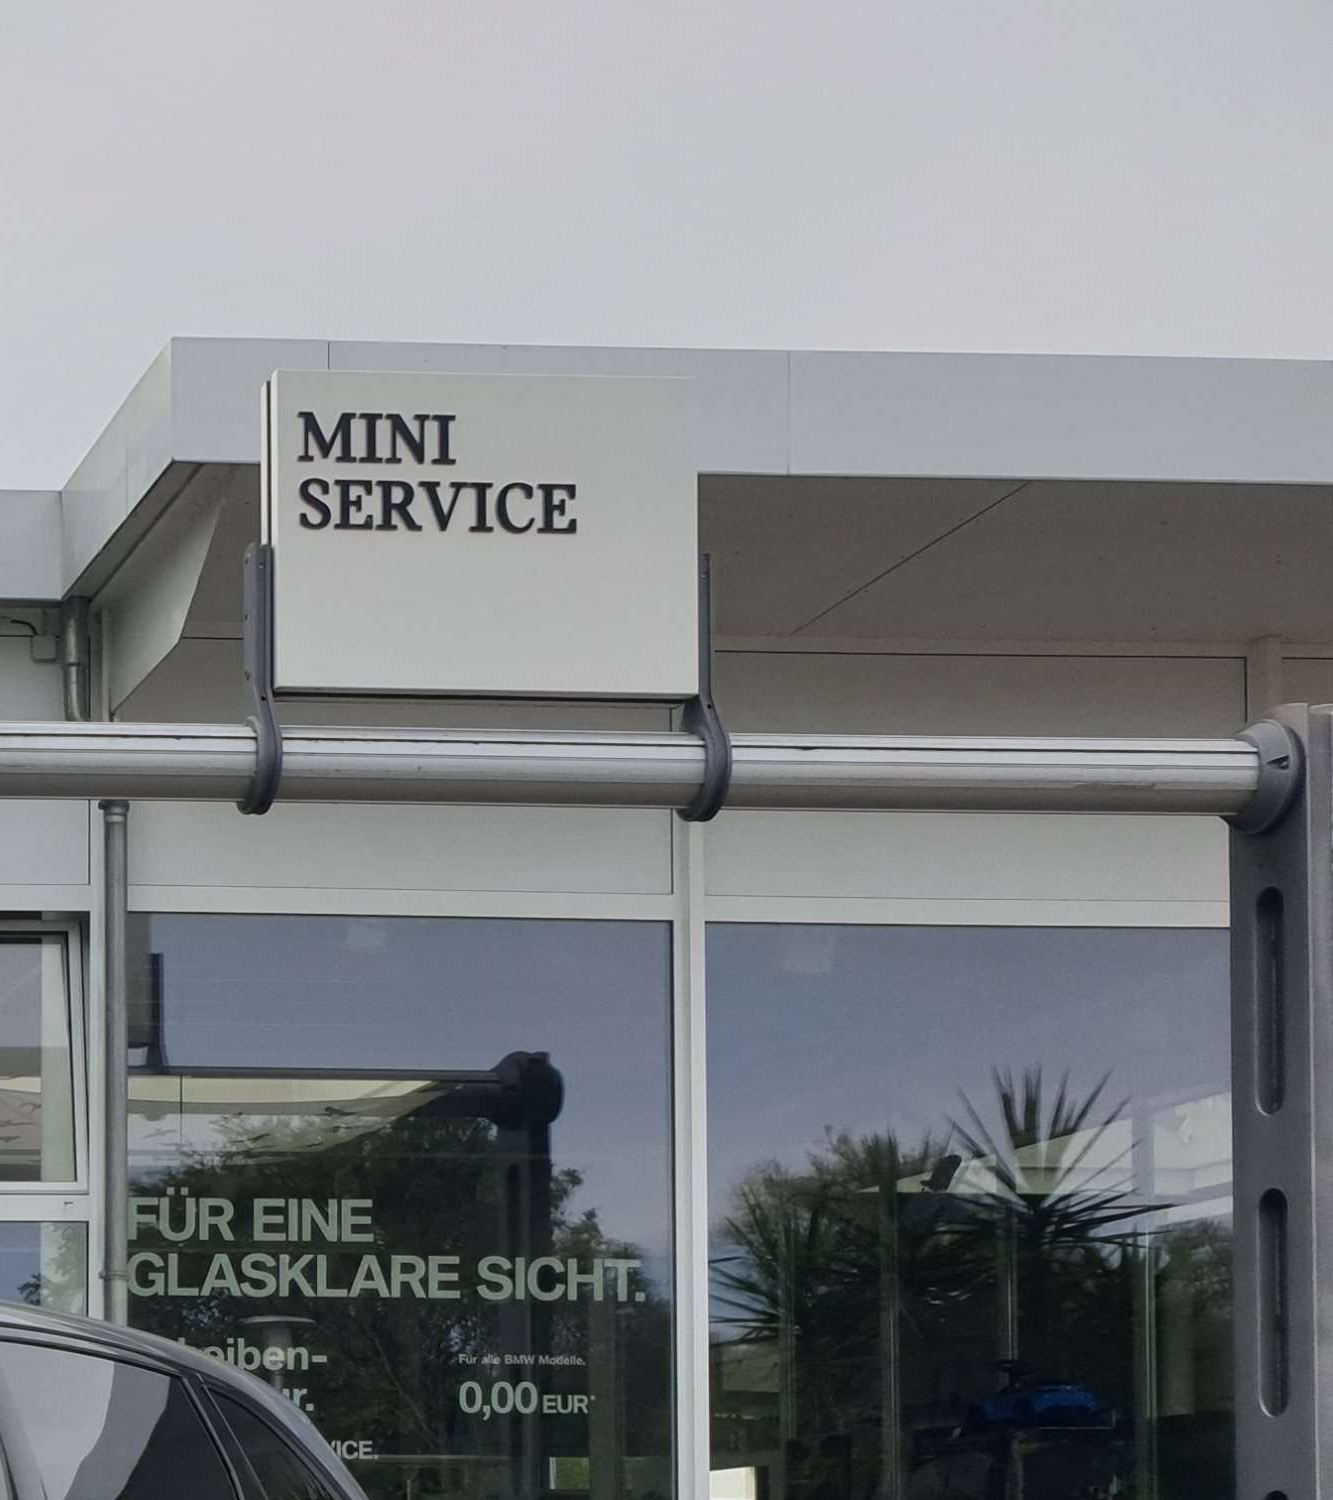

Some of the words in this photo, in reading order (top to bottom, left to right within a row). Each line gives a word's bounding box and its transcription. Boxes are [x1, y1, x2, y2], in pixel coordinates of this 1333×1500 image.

[296, 411, 457, 465] MINI
[298, 477, 578, 535] SERVICE
[127, 1187, 235, 1242] FÜR
[252, 1197, 375, 1242] EINE
[127, 1251, 461, 1299] GLASKLARE
[476, 1255, 647, 1303] SICHT.
[177, 1337, 328, 1371] eiben-
[458, 1353, 477, 1365] Für
[481, 1353, 501, 1365] alle
[504, 1354, 535, 1366] BMW
[459, 1380, 538, 1421] 0,00
[330, 1439, 379, 1460] ICE.
